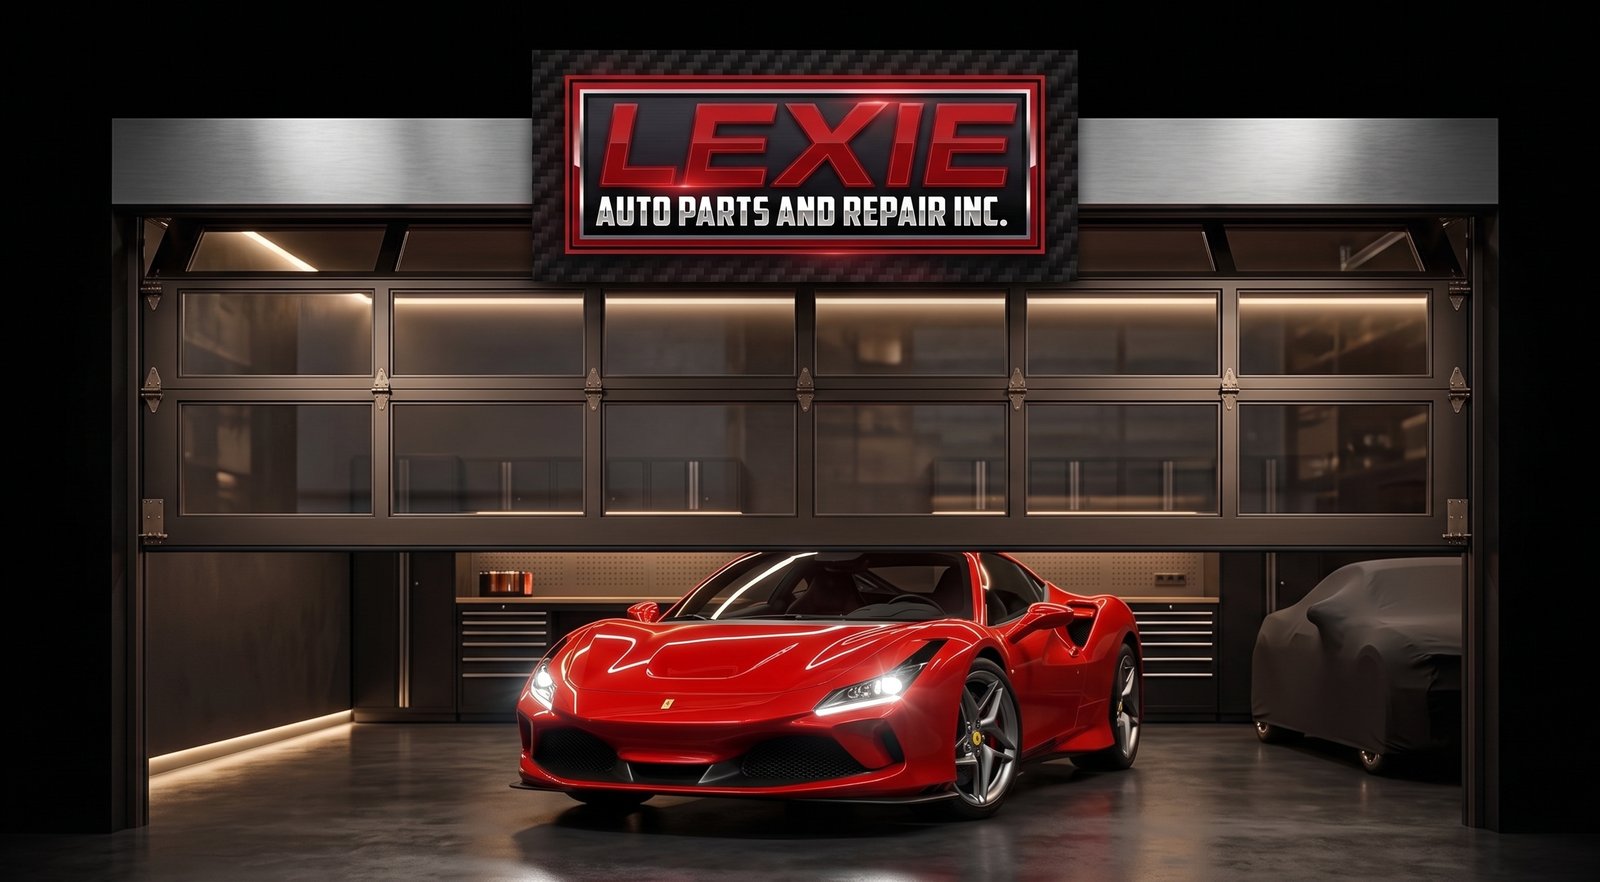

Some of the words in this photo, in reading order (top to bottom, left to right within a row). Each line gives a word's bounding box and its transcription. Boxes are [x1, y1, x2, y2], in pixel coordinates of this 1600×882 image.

[600, 102, 1018, 187] LEXIE
[596, 195, 671, 227] AUTO
[678, 195, 769, 227] PARTS
[776, 195, 835, 227] AND
[843, 195, 946, 227] REPAIR
[953, 195, 1008, 227] INC.
